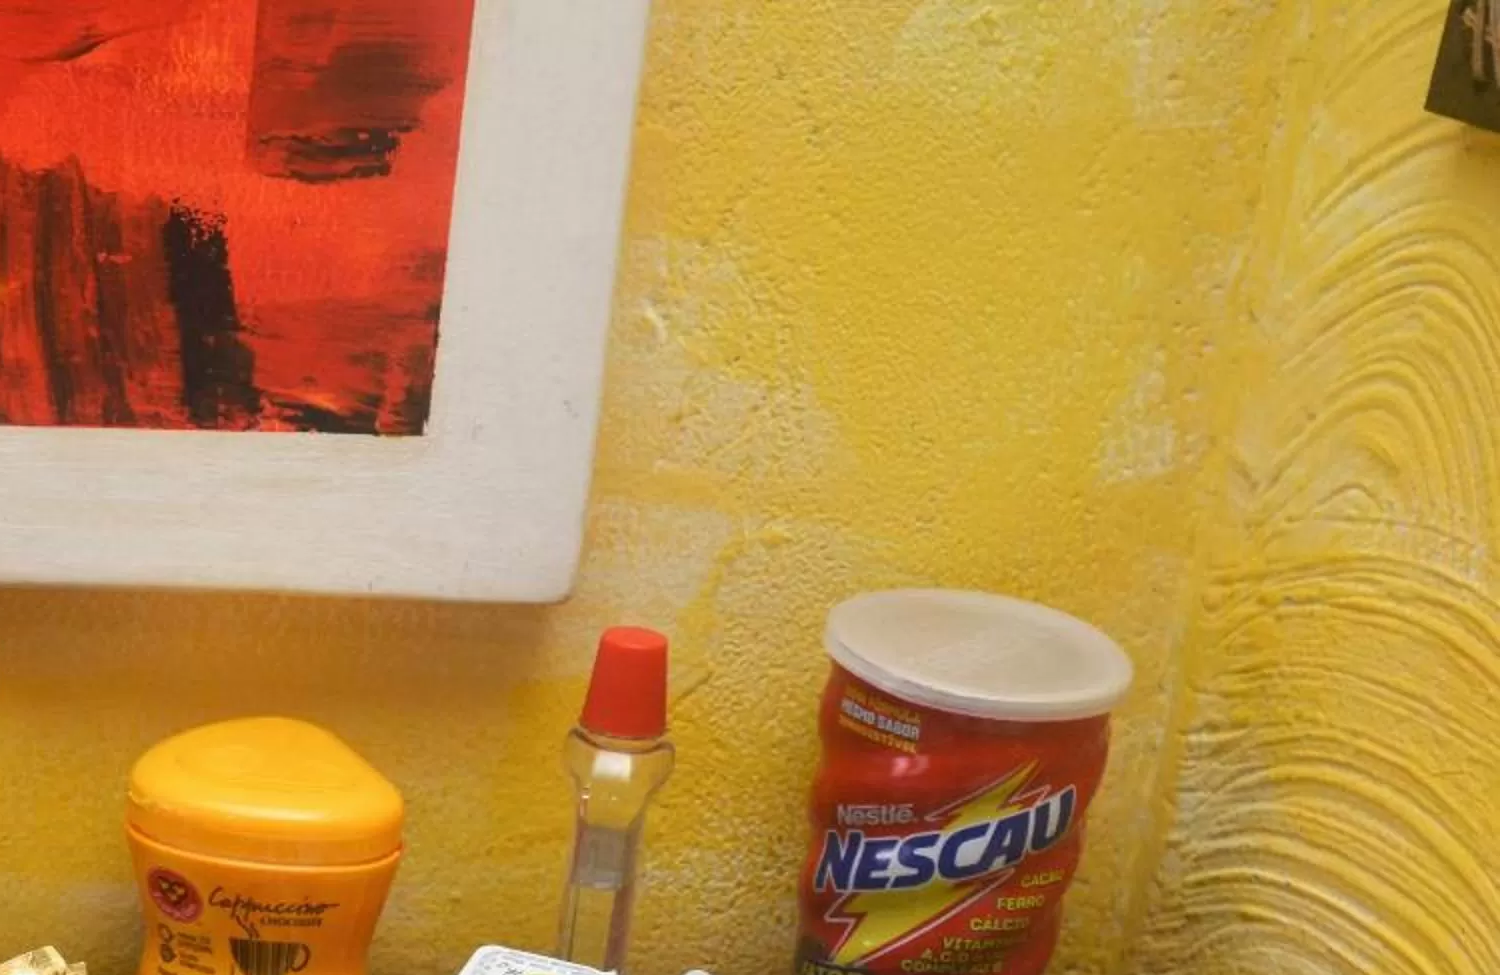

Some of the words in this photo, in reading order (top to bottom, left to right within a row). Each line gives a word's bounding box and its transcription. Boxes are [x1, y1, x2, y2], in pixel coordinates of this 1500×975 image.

[837, 803, 914, 825] Nestlé
[813, 784, 1077, 893] NESCAU
[996, 894, 1045, 911] FERRO
